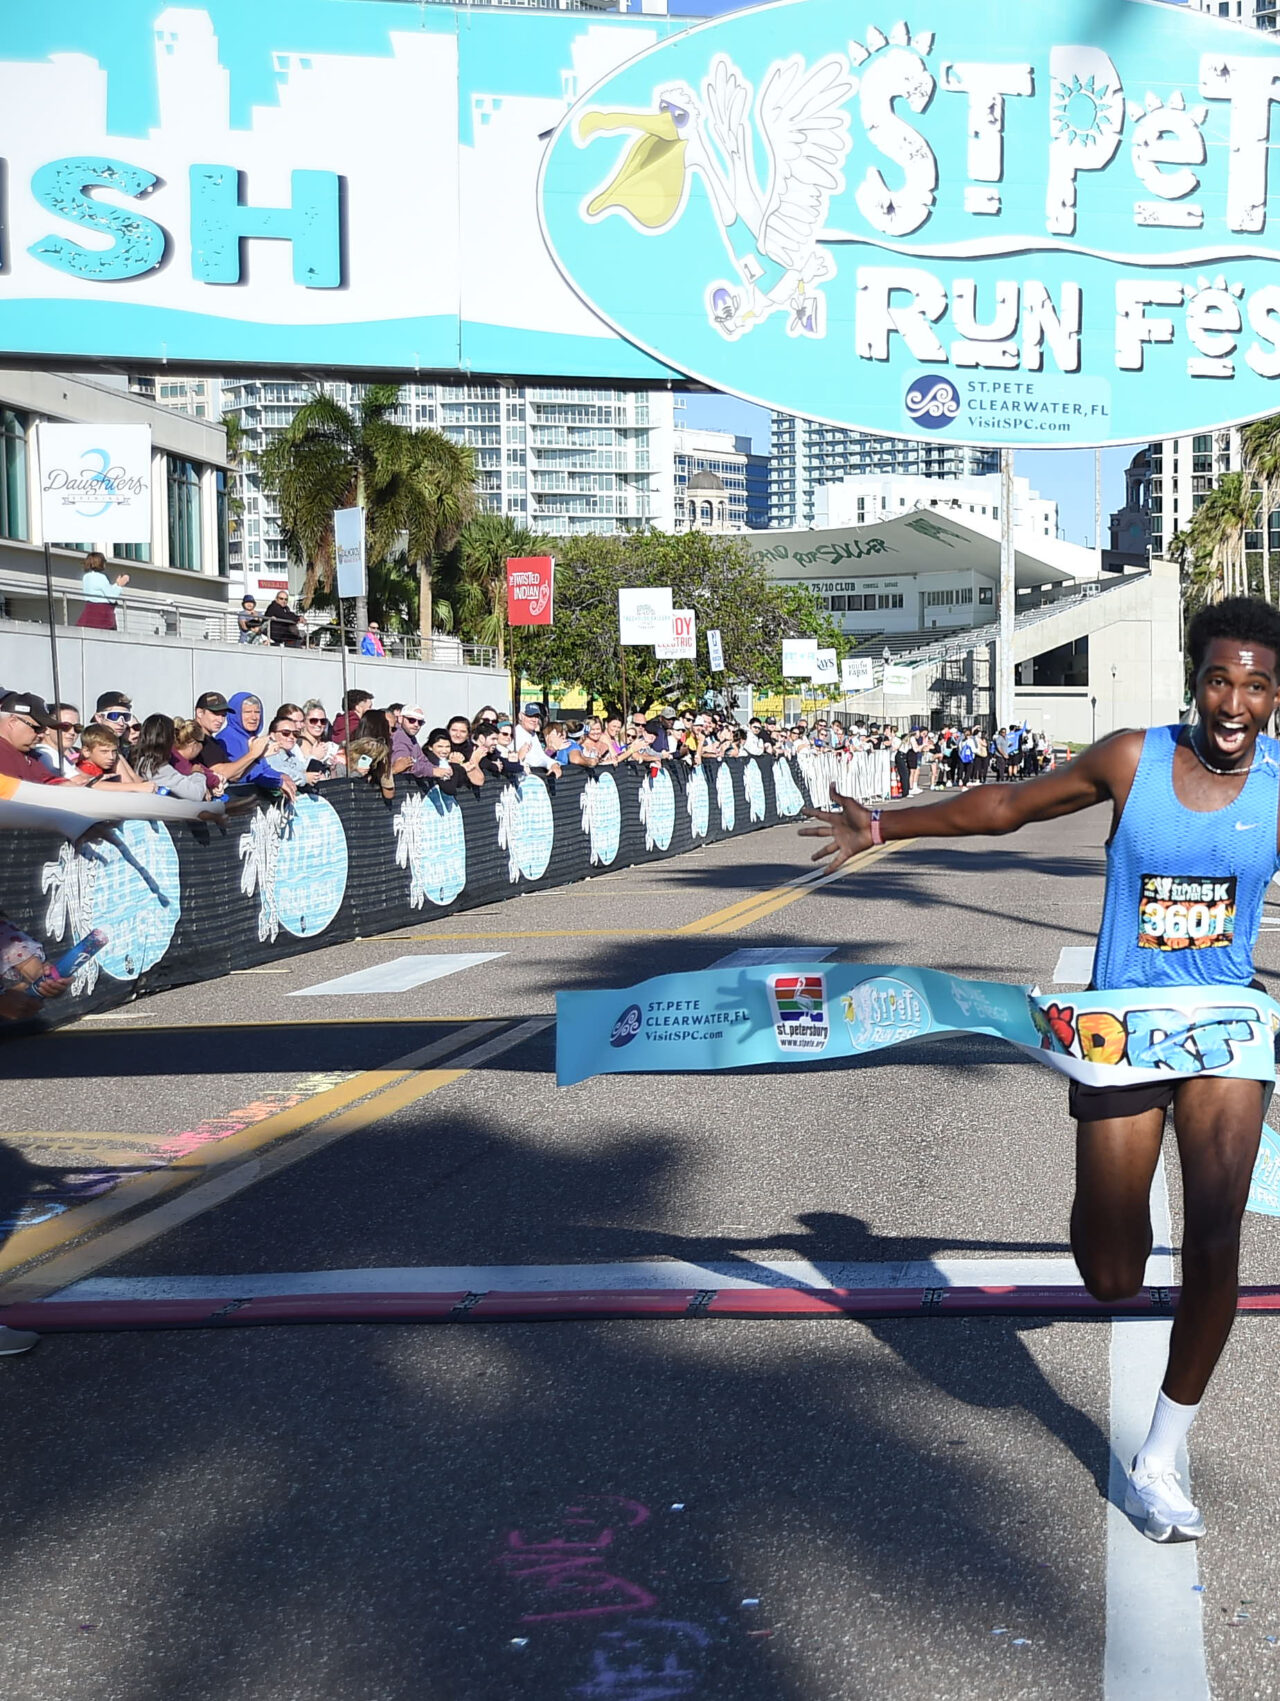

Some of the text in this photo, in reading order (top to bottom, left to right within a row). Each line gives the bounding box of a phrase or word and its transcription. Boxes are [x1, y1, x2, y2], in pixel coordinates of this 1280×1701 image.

[0, 156, 348, 290] SH
[855, 266, 1082, 375] RUN
[967, 381, 1035, 395] ST.PETE
[967, 398, 1109, 418] CLEARWATER,FL
[968, 416, 1071, 432] VisitSPC.com
[44, 466, 148, 495] Daughters
[513, 585, 540, 600] INDIAN
[811, 583, 834, 592] 75/10
[835, 582, 856, 592] CLUB
[672, 616, 692, 636] DY
[1201, 883, 1230, 901] 5K
[1144, 902, 1226, 937] 3601
[647, 1000, 701, 1012] ST.PETE
[646, 1010, 751, 1027] CLEARWATER,FL
[644, 1030, 724, 1042] VisitSPC.com
[776, 1022, 829, 1040] st.petersburg
